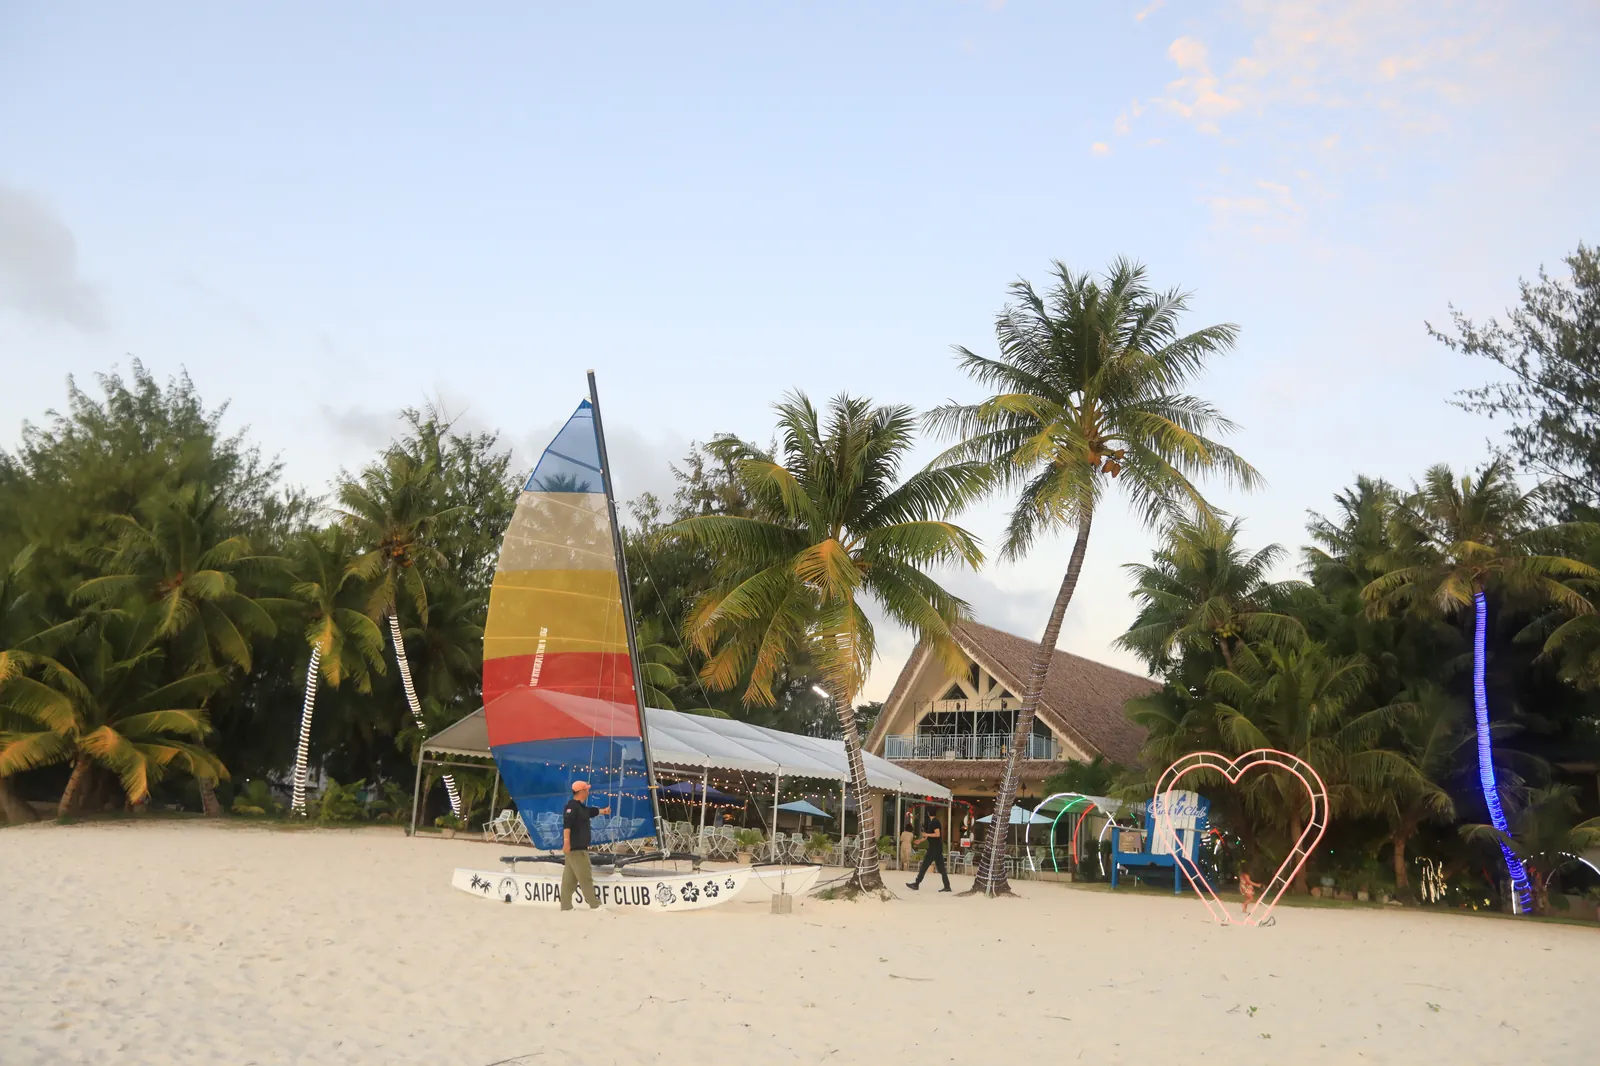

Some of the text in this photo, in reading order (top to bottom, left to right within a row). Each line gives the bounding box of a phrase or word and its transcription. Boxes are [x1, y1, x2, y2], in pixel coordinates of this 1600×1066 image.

[1184, 806, 1206, 818] Club
[525, 882, 651, 906] SAIPA SRF CLUB
